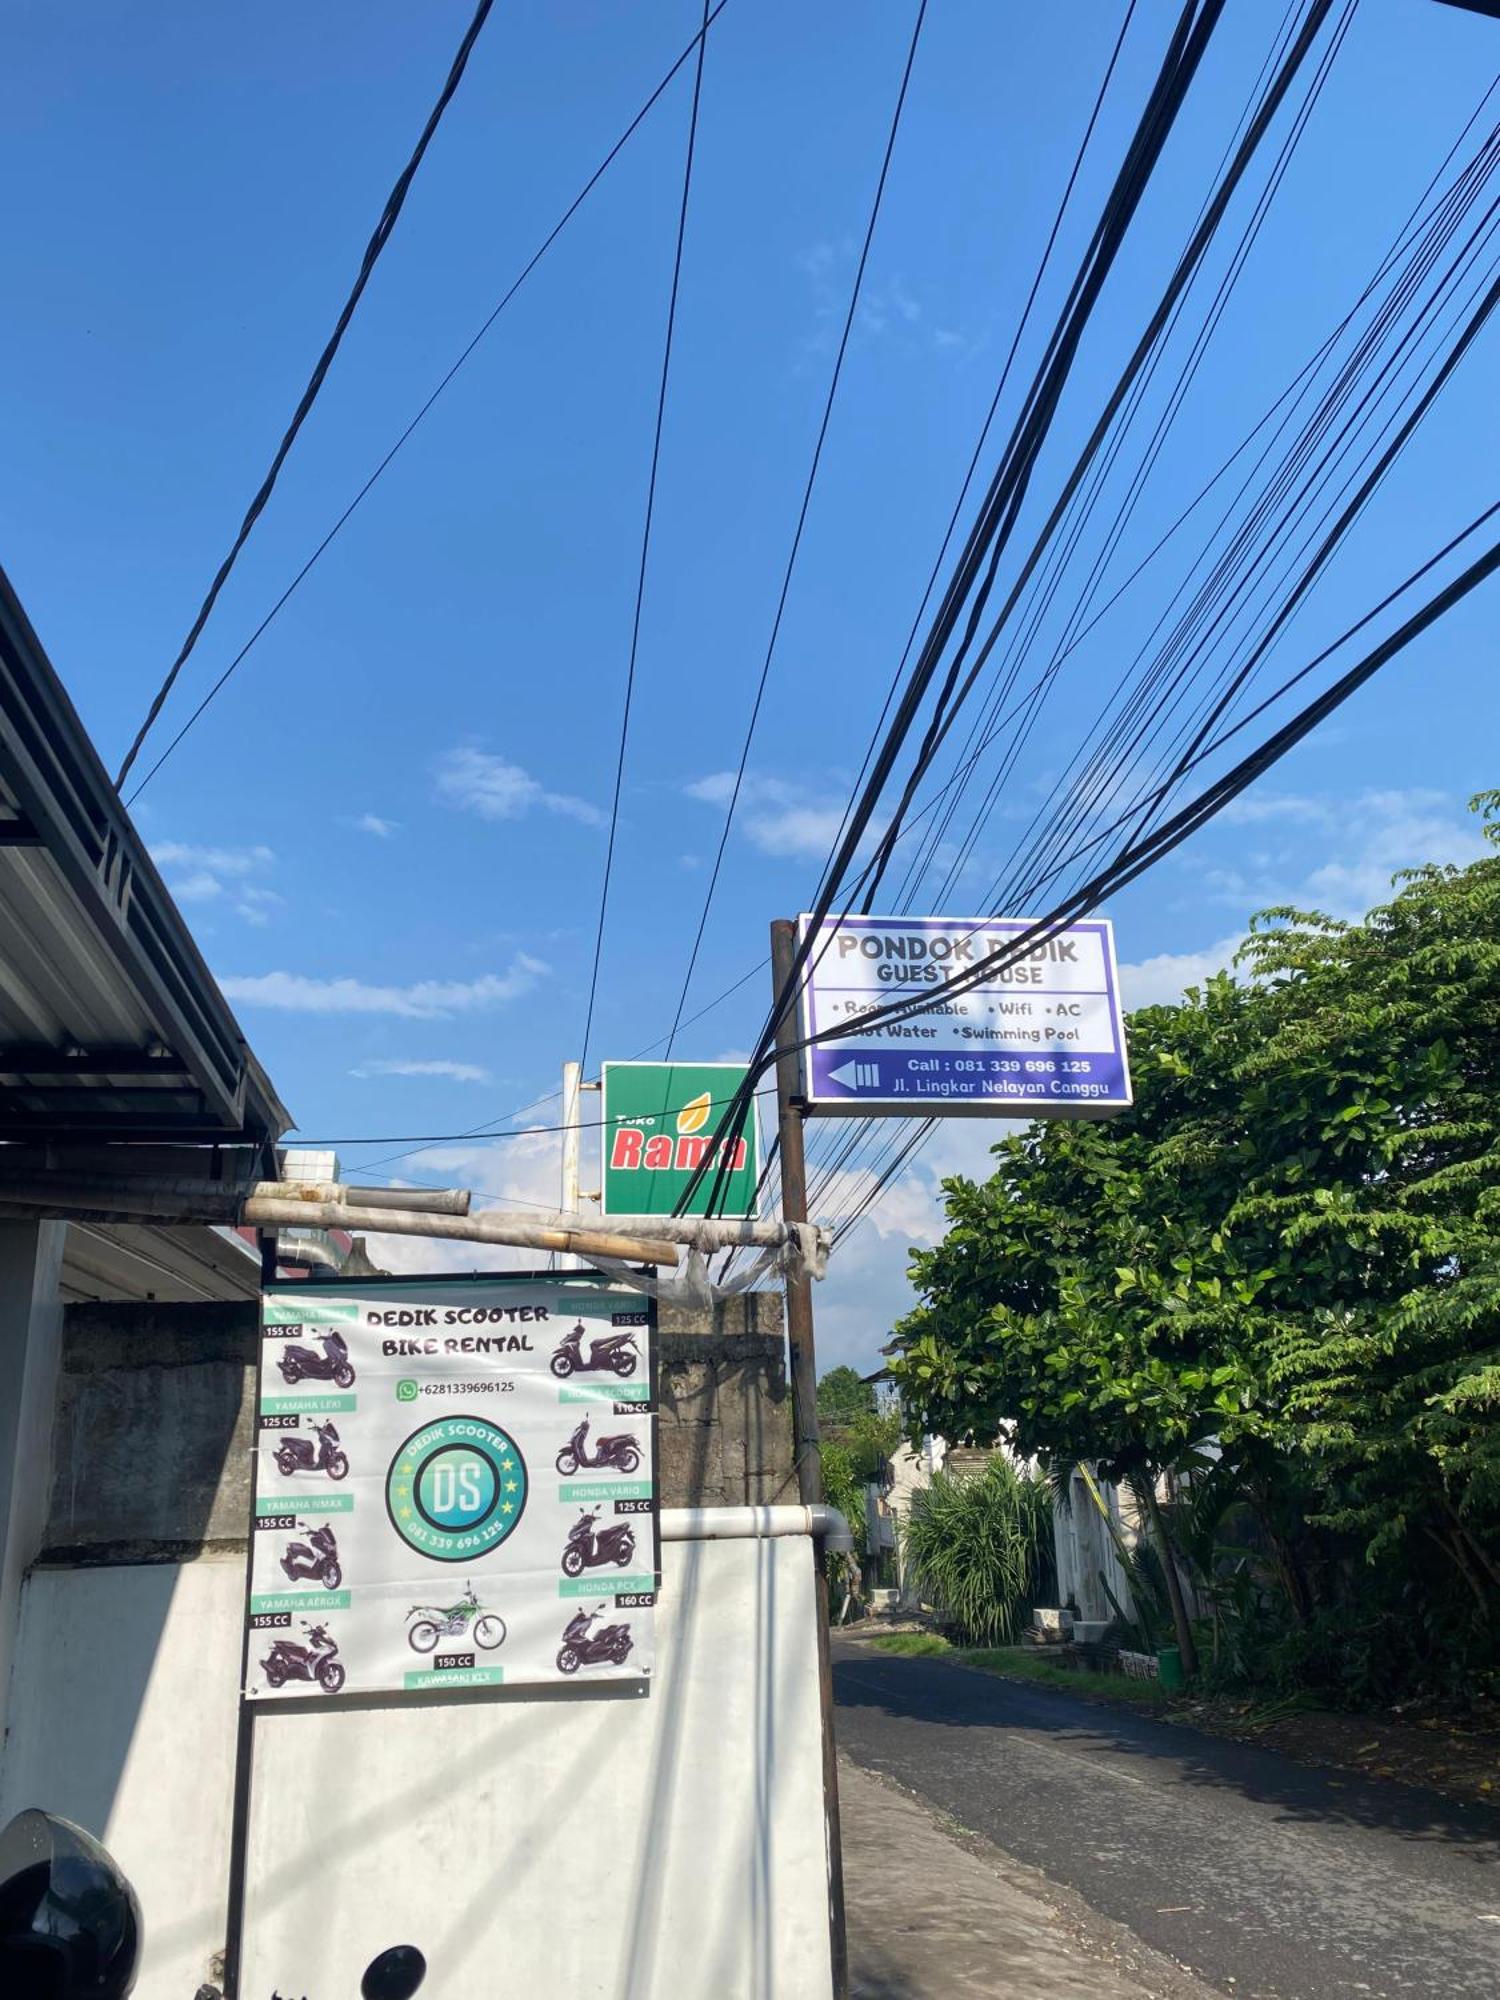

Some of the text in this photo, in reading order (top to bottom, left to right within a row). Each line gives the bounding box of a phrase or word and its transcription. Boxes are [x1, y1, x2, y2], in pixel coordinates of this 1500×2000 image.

[838, 935, 974, 960] PONDOK
[877, 964, 1042, 984] GUEST OUSE
[844, 1001, 893, 1014] Roo
[998, 1003, 1032, 1015] Wifi
[1056, 1004, 1081, 1016] AC
[886, 1025, 937, 1038] Water
[961, 1027, 1040, 1042] Swimming
[1045, 1027, 1080, 1040] Pool
[908, 1059, 939, 1072] Call
[955, 1060, 985, 1072] 081
[991, 1061, 1020, 1072] 339
[1025, 1061, 1056, 1073] 696
[1062, 1061, 1091, 1073] 125
[893, 1079, 1109, 1097] Jl. Lingkar Nelayan Canggu
[610, 1128, 747, 1171] Rama
[367, 1309, 438, 1327] DEDIK
[444, 1306, 549, 1325] SCOOTER
[616, 1316, 646, 1324] 125 CC
[266, 1326, 299, 1336] 155 CC
[382, 1335, 534, 1356] BIKE RENTAL
[418, 1382, 515, 1395] +6281339696125
[275, 1402, 318, 1410] YAMAHA
[264, 1417, 296, 1427] 125 CC
[407, 1425, 508, 1456] DEDIK SCOOTER
[433, 1463, 481, 1513] DS
[572, 1486, 640, 1497] HONDA VARIO
[267, 1502, 309, 1511] YAMAHA
[619, 1502, 650, 1511] 125 CC
[259, 1517, 292, 1528] 155 CC
[407, 1520, 503, 1549] 081 339 696 125
[578, 1583, 615, 1592] HONDA
[261, 1600, 304, 1610] YAMAHA
[619, 1596, 652, 1605] 160 CC
[254, 1615, 288, 1627] 155 CC
[439, 1656, 472, 1667] 150 CC
